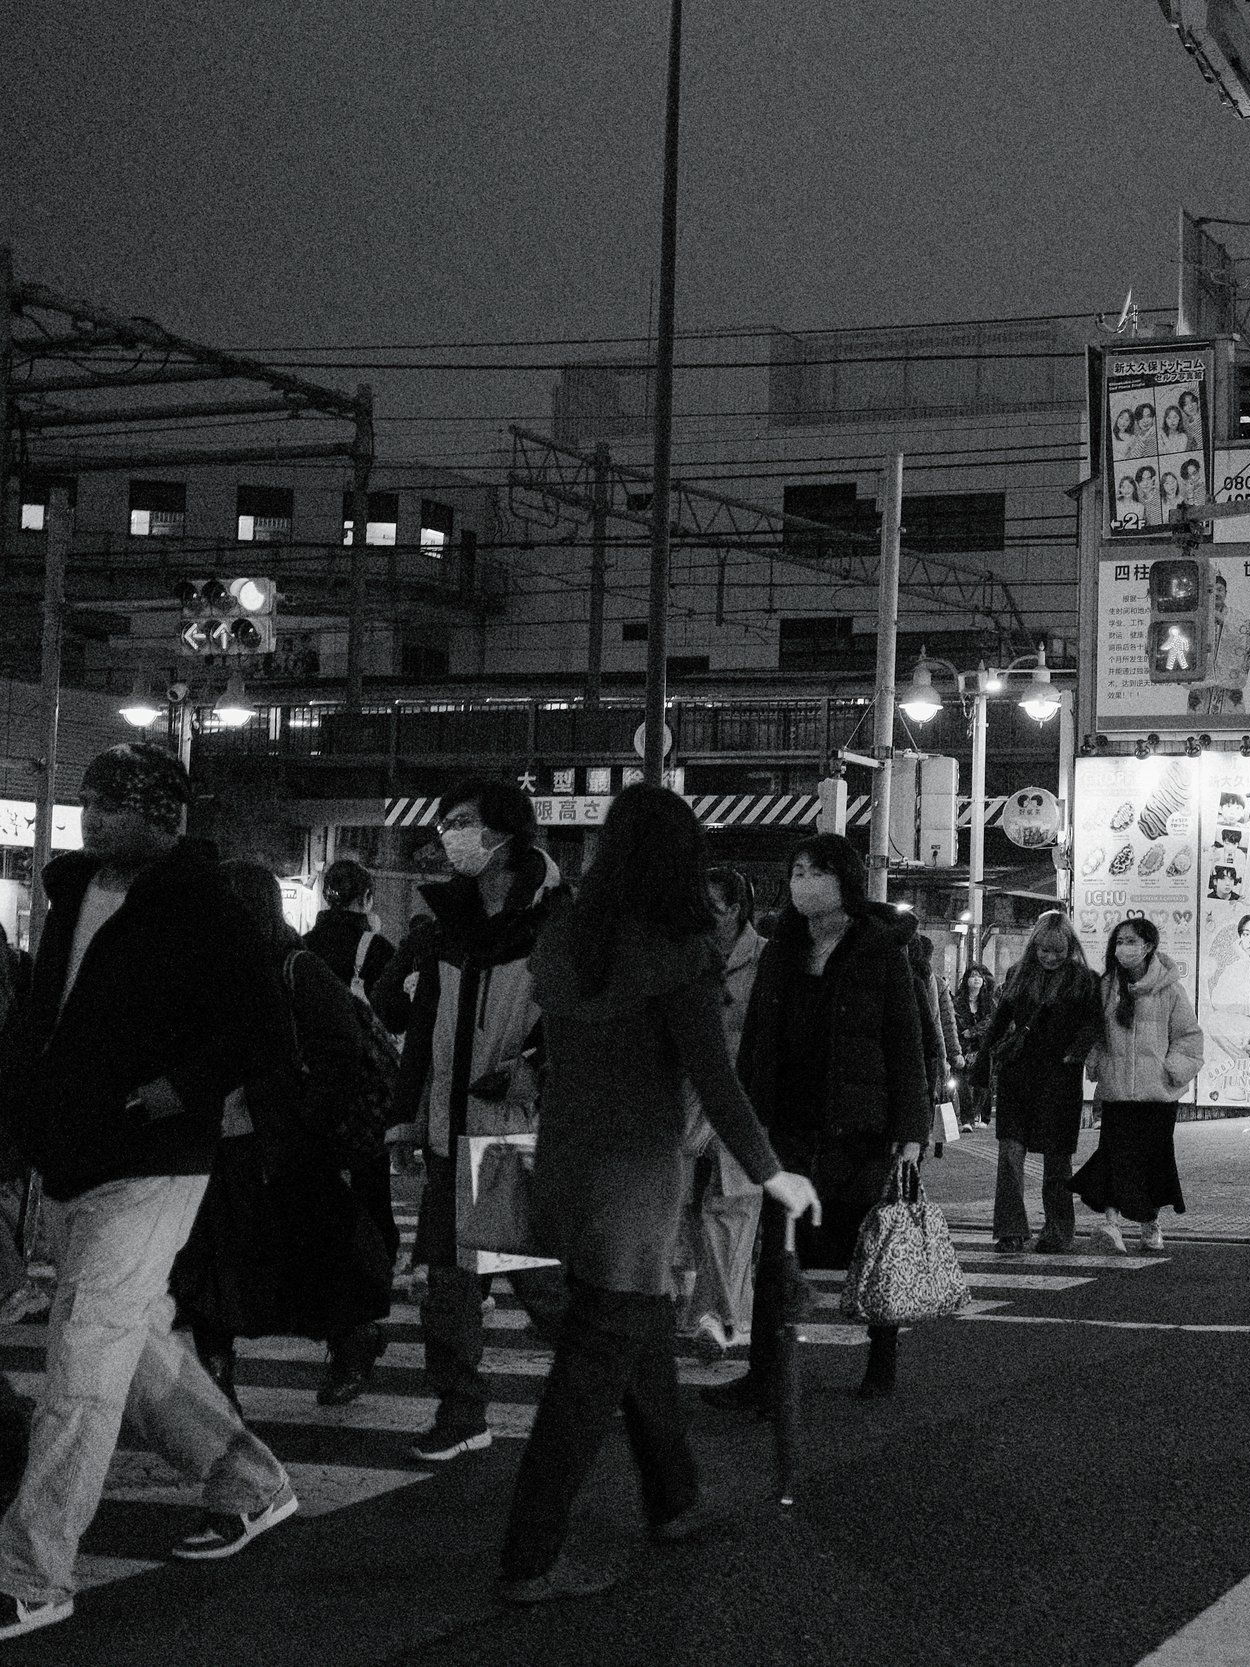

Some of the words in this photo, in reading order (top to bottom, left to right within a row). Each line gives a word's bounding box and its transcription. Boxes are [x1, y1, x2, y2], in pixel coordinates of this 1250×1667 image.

[1114, 359, 1206, 376] 新大久保ドットコム
[1123, 512, 1146, 530] 2F
